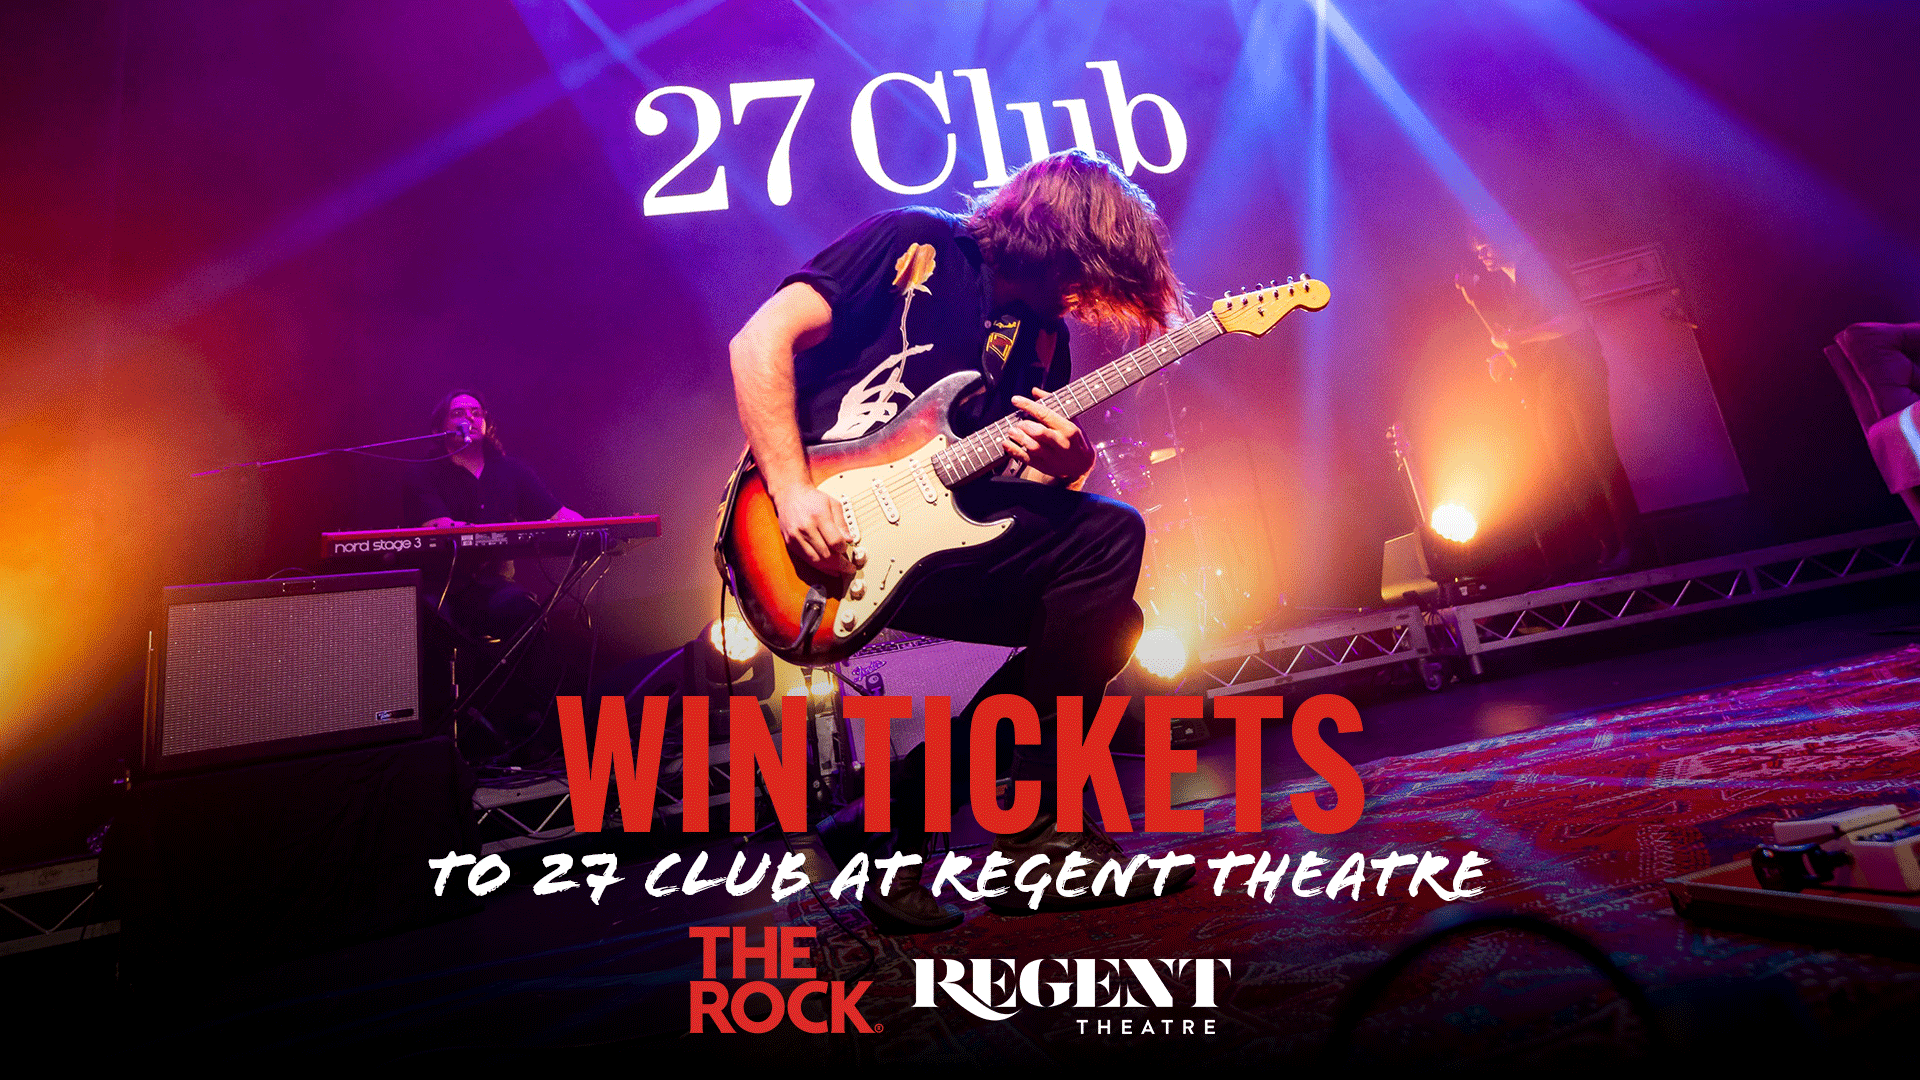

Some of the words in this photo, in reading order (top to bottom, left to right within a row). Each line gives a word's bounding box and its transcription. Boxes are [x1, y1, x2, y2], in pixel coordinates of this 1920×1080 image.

[634, 78, 815, 217] 27
[850, 60, 1188, 195] Club
[334, 540, 370, 554] nord
[372, 539, 412, 552] stage
[413, 537, 422, 549] 3
